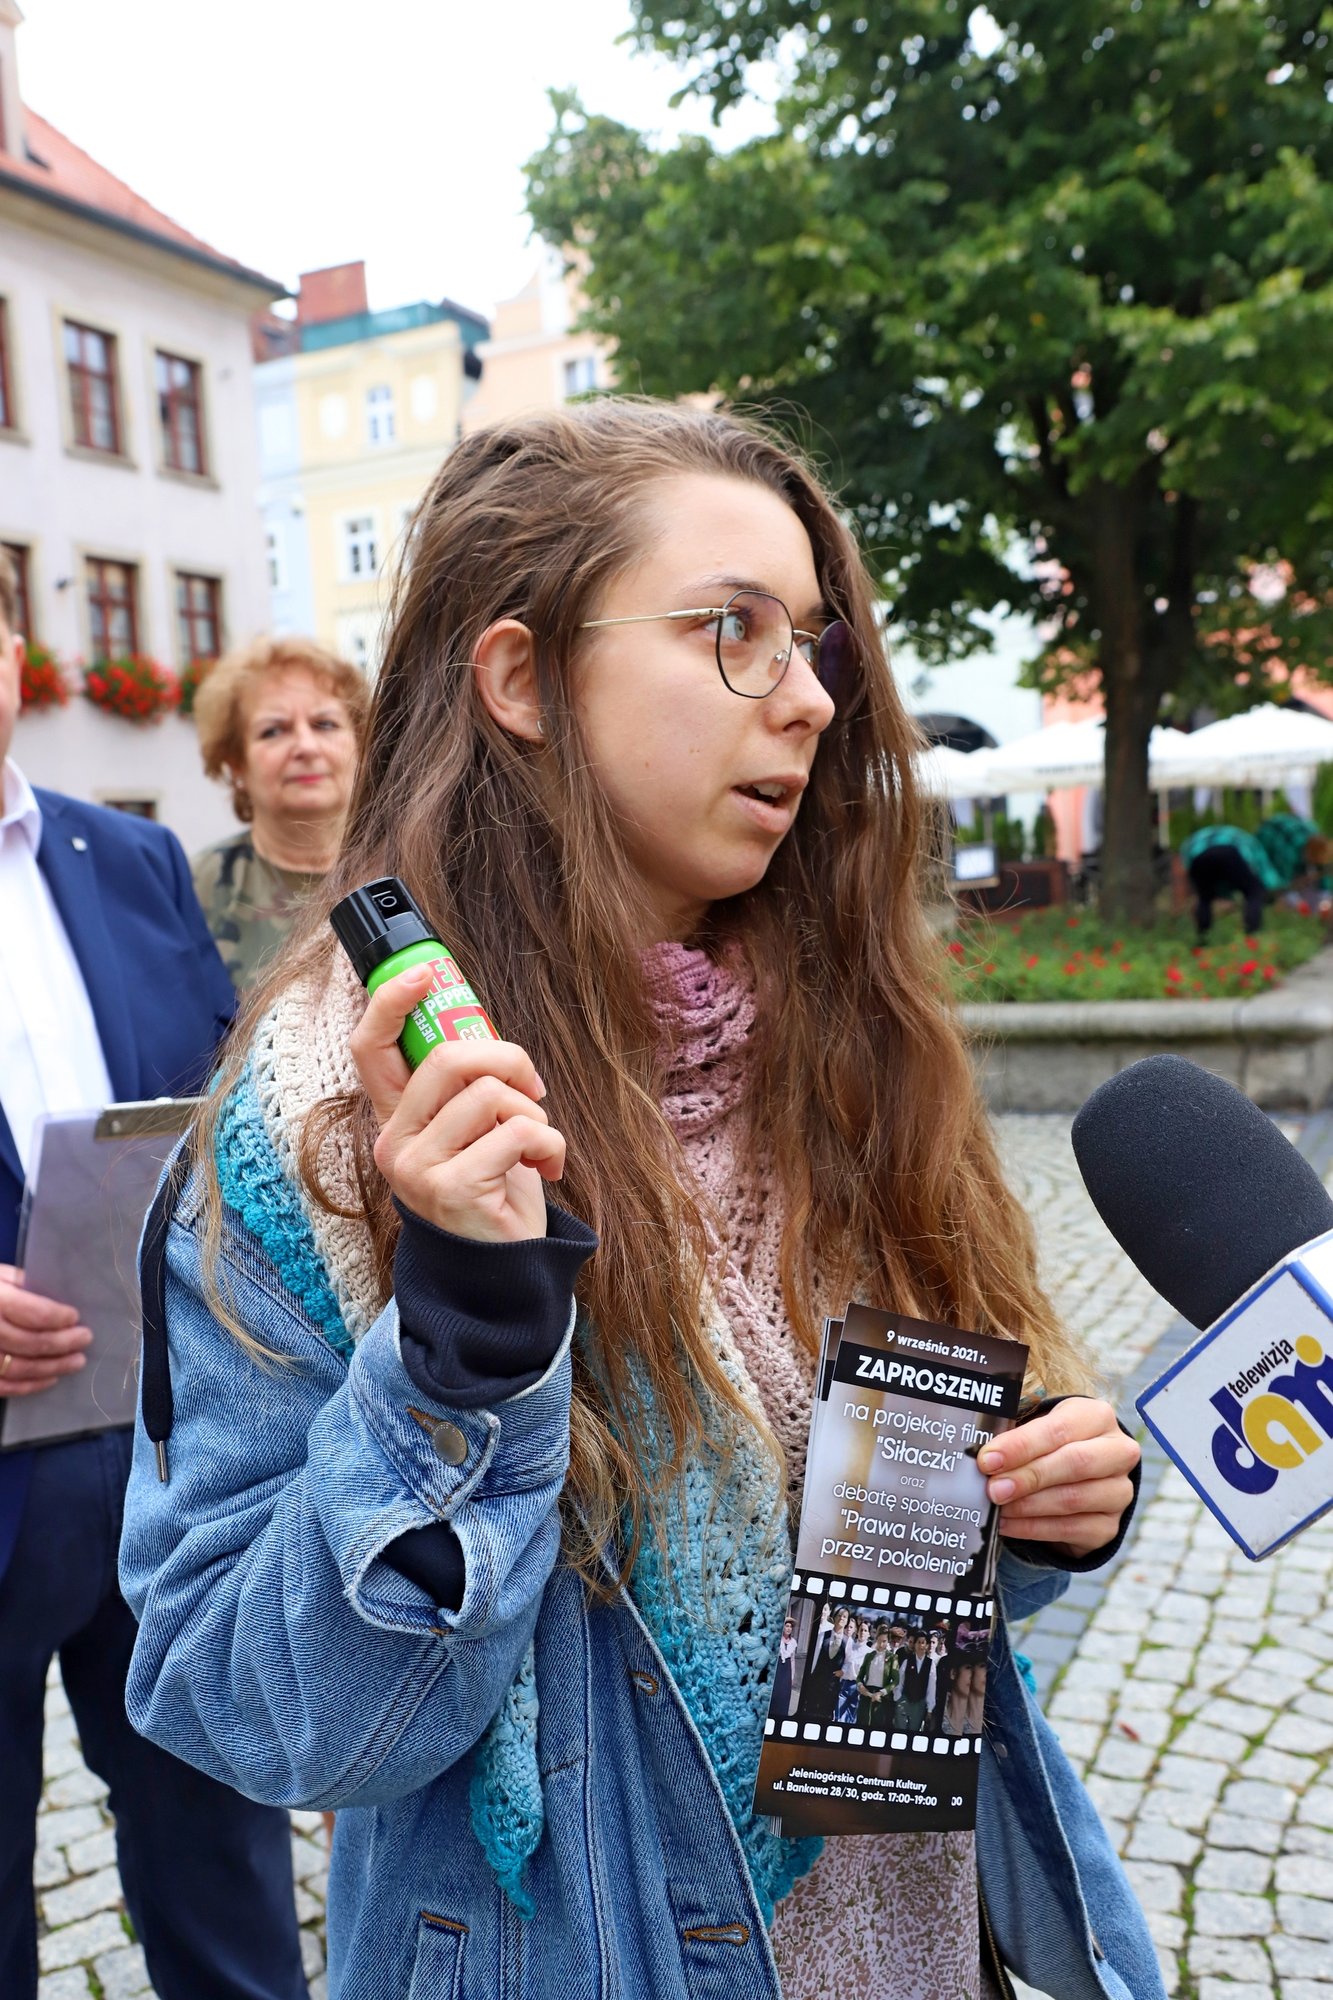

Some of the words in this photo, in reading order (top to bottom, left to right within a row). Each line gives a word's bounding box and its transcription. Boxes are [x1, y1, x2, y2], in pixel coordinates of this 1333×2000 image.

[421, 957, 466, 1001] ED
[423, 985, 479, 1017] PEPPE
[886, 1330, 896, 1342] 9
[897, 1335, 949, 1355] września
[951, 1346, 978, 1362] 2021
[979, 1353, 988, 1365] r.
[1228, 1338, 1294, 1398] telewizja
[855, 1354, 1004, 1408] ZAPROSZENIE
[843, 1401, 869, 1421] na
[872, 1407, 956, 1444] projekcję
[876, 1436, 963, 1472] "Siłaczki"
[900, 1474, 925, 1489] oraz
[832, 1481, 897, 1511] debatę
[900, 1498, 981, 1527] społeczną
[840, 1508, 906, 1539] "Prawa
[910, 1522, 967, 1549] kobiet
[820, 1536, 874, 1562] przez
[877, 1547, 974, 1577] pokolenia"
[773, 1780, 785, 1792] ul.
[786, 1781, 829, 1796] Bankowa
[829, 1785, 860, 1800] 28/30,
[861, 1790, 886, 1802] godz.
[887, 1791, 938, 1807] 17:00-19:00
[788, 1767, 855, 1783] Jeleniogórskie
[856, 1774, 895, 1788] Centrum
[895, 1779, 928, 1793] Kultury
